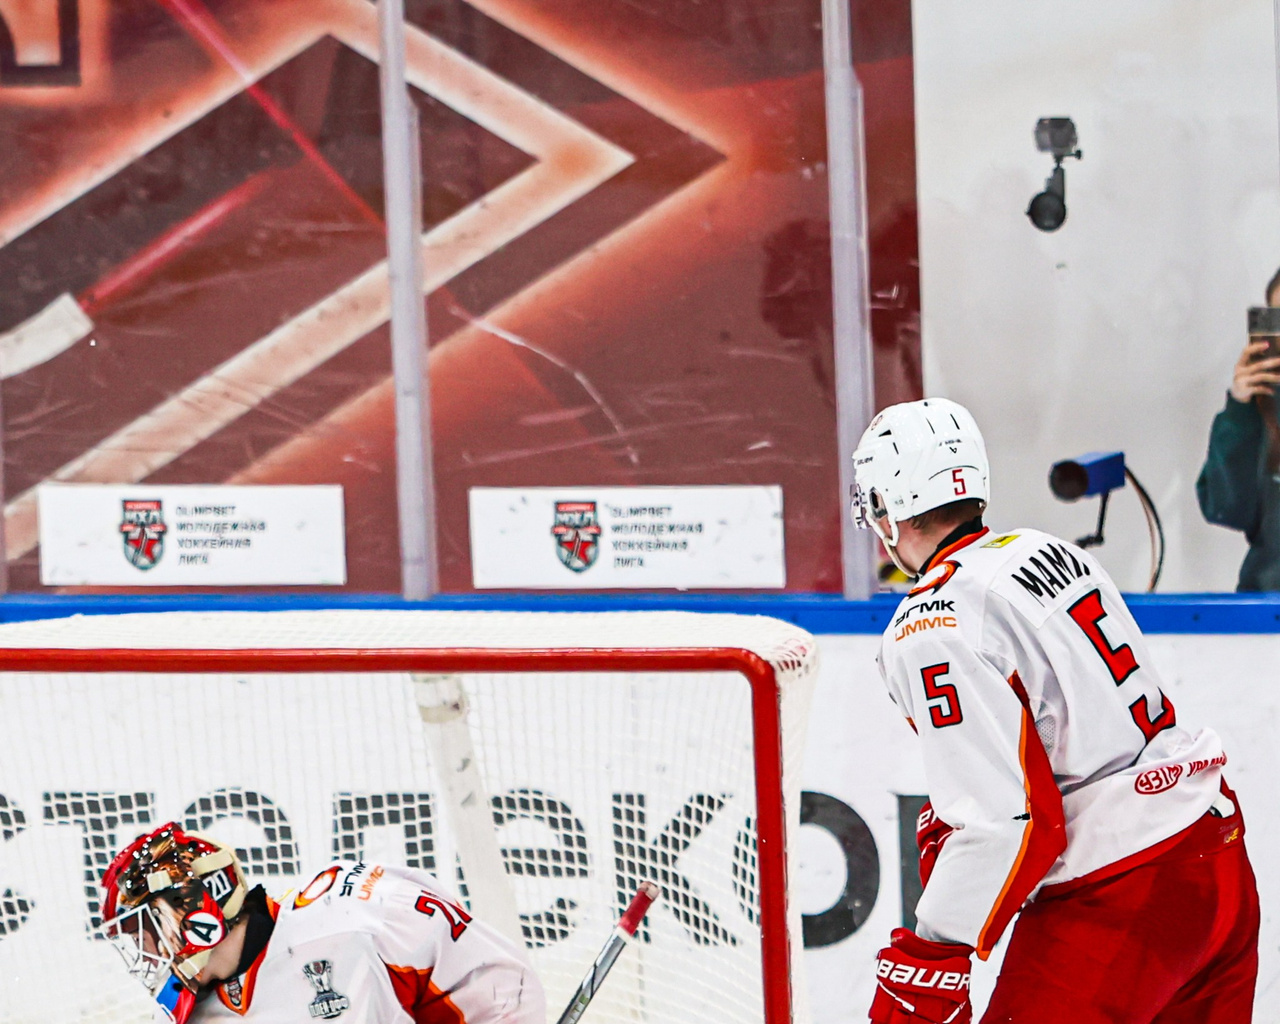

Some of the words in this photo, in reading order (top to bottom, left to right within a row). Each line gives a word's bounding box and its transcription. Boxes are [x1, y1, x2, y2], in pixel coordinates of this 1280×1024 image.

[951, 468, 967, 496] 5
[894, 600, 955, 627] УГМК
[894, 616, 958, 642] UMMC
[920, 661, 964, 729] 5
[202, 871, 231, 901] 20
[876, 957, 970, 992] BAUER
